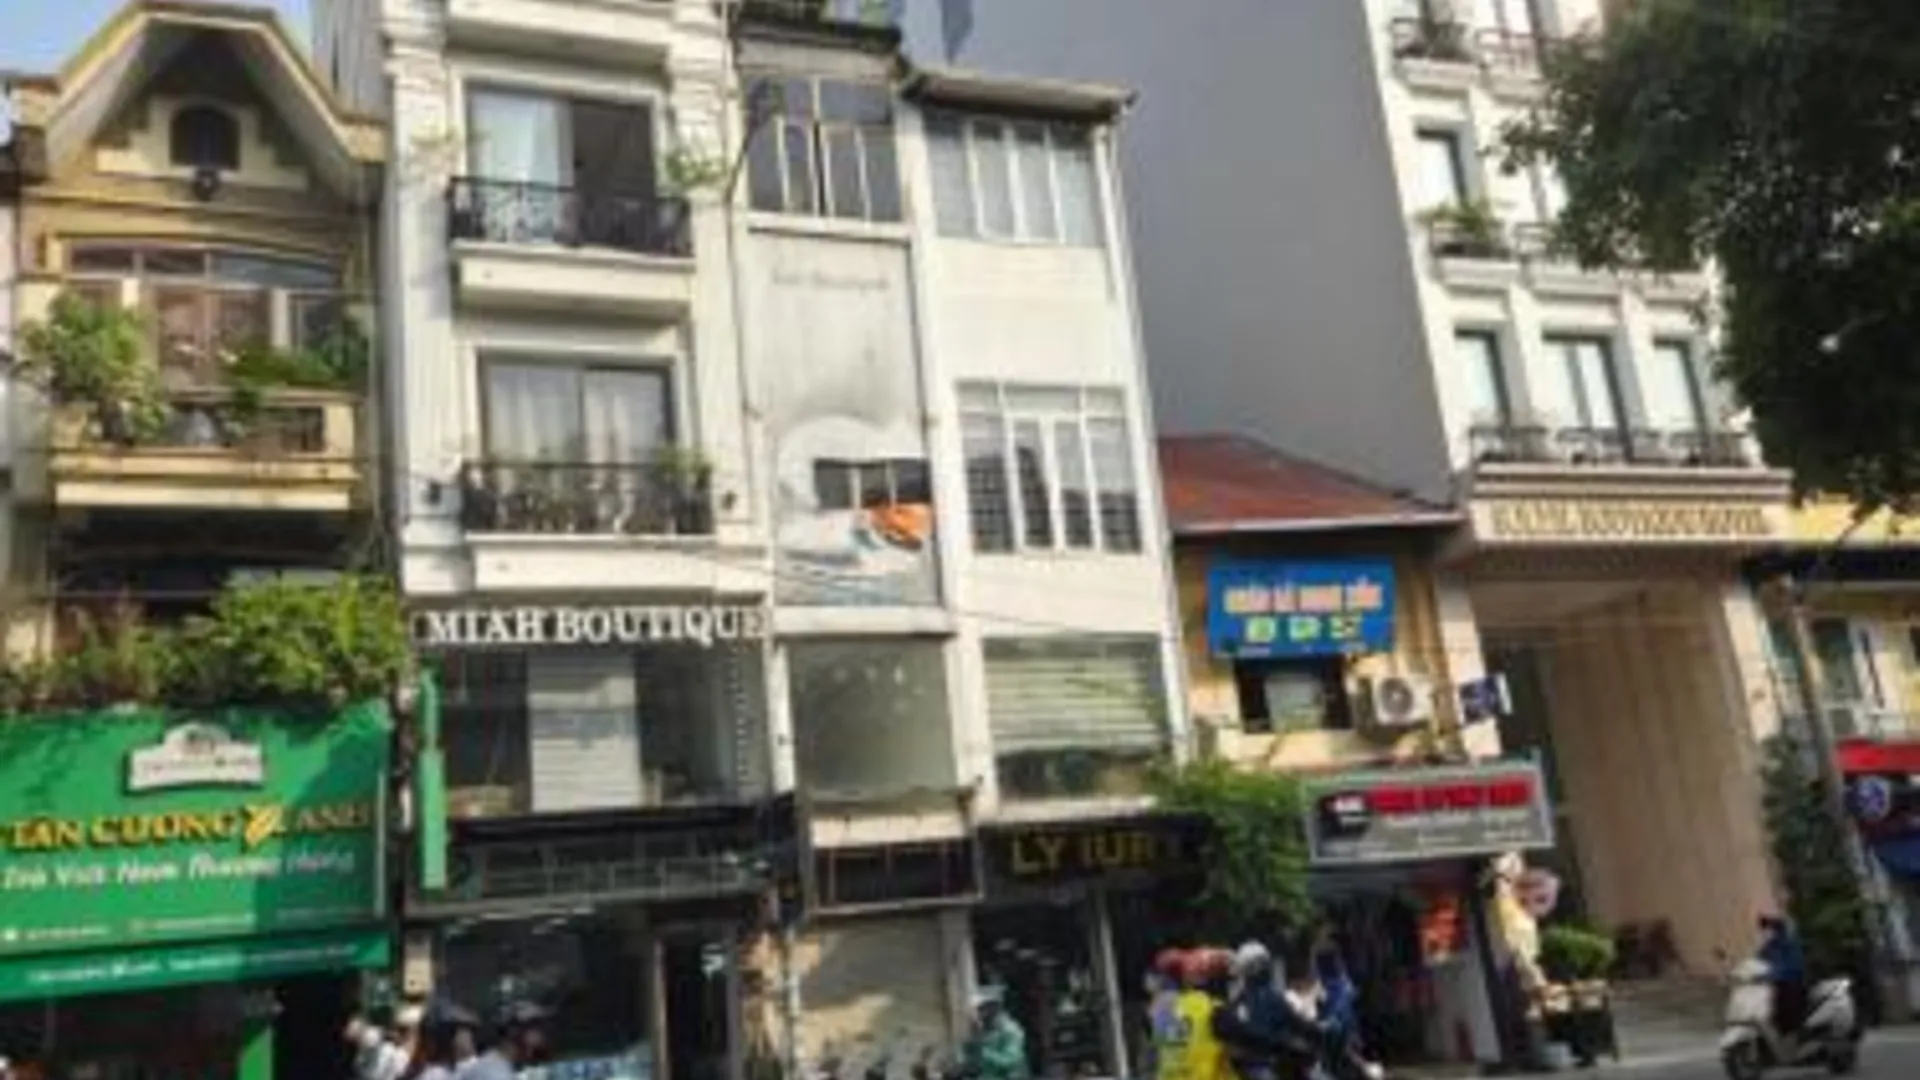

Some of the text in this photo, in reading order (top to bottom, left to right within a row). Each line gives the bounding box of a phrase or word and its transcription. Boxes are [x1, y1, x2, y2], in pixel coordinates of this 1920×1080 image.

[426, 605, 767, 648] MIAH BOUTIQUE
[1011, 831, 1066, 875] LY
